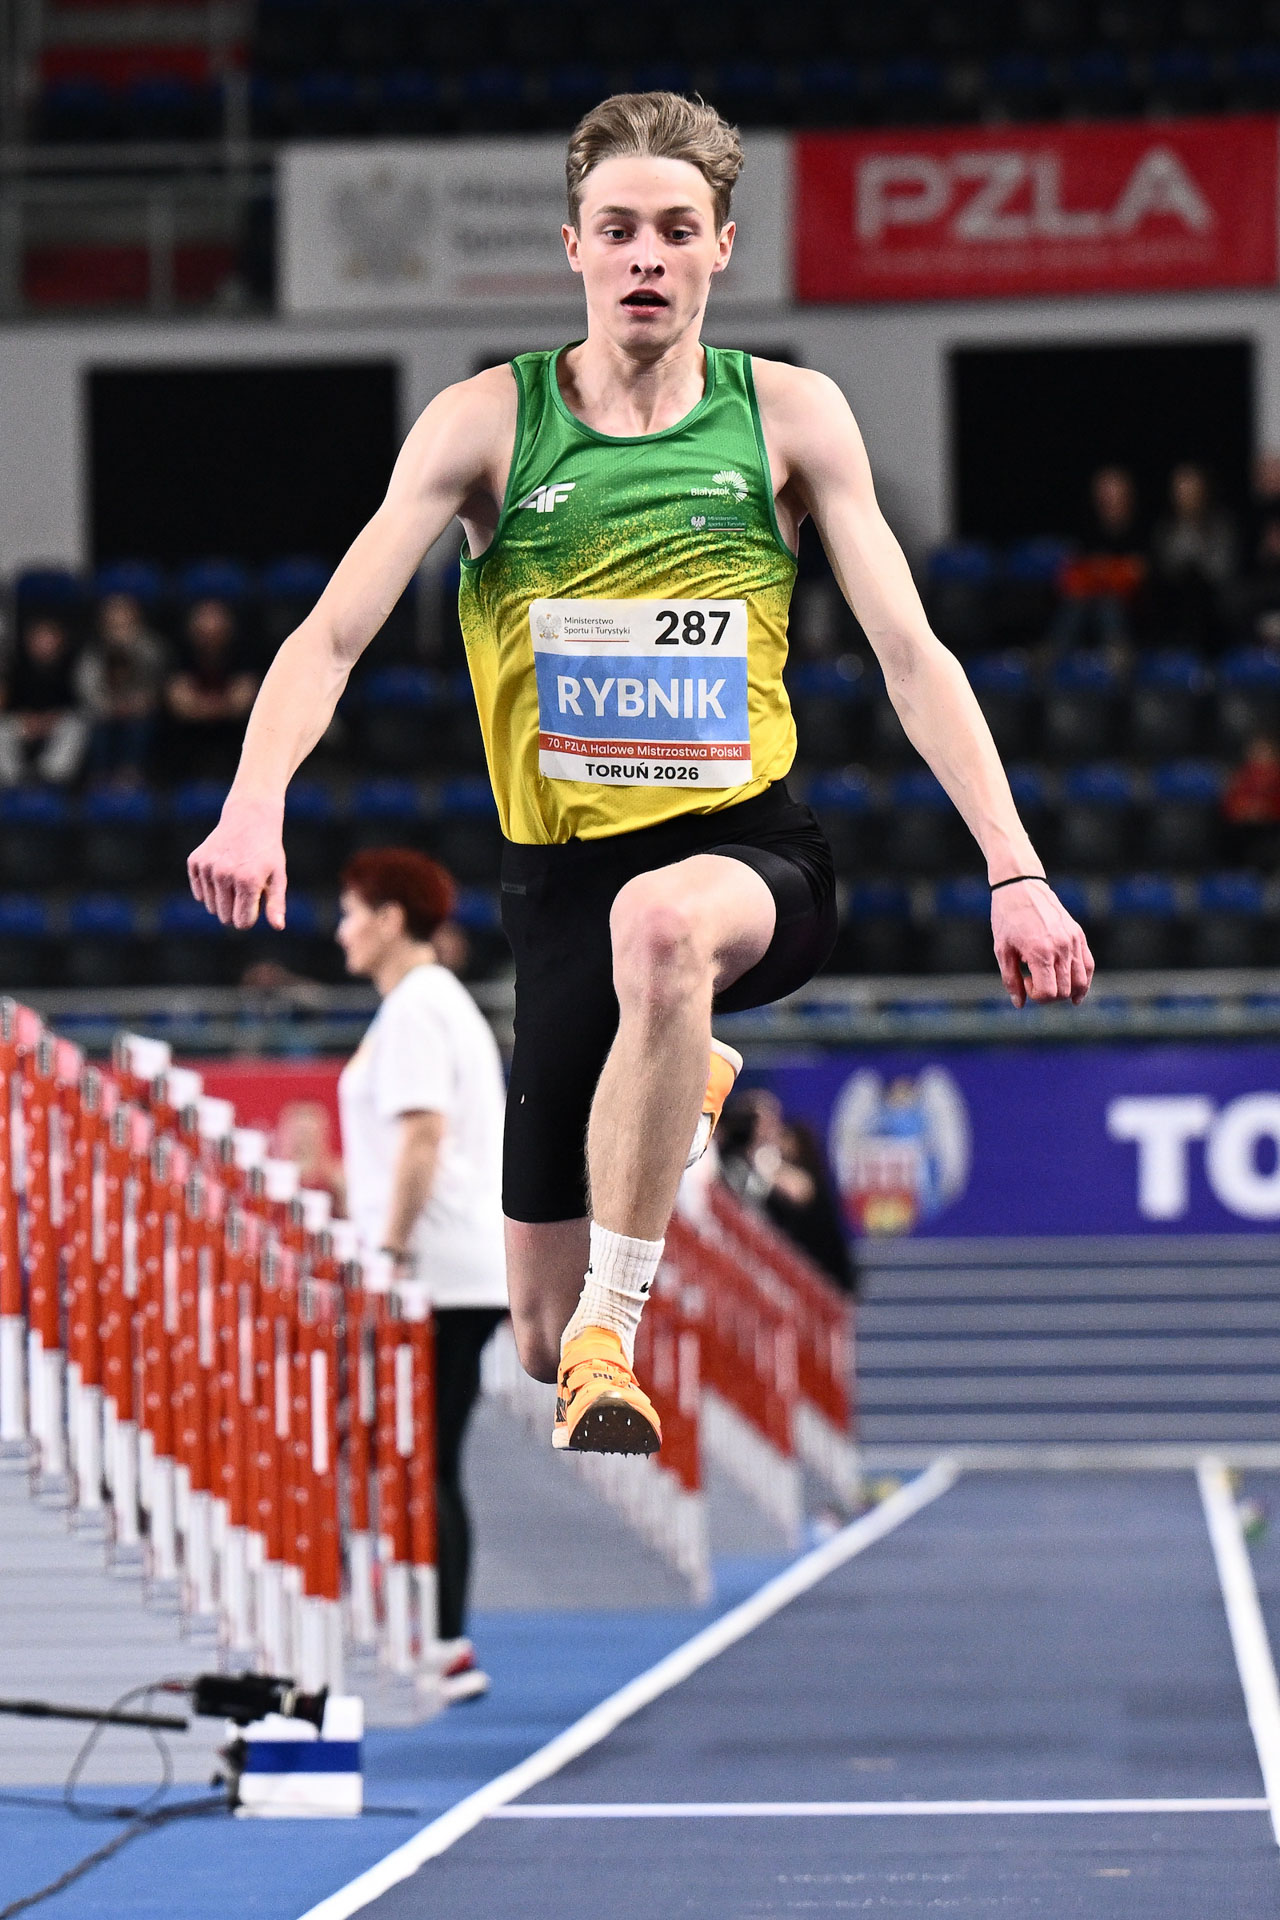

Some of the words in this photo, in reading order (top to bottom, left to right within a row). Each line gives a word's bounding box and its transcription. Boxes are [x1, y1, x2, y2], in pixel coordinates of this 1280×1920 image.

[854, 146, 1214, 244] PZLA
[563, 626, 589, 636] Sportu
[595, 627, 631, 636] Turystyki
[564, 616, 614, 625] Ministerstwo
[655, 610, 731, 646] 287
[557, 675, 727, 719] RYBNIK
[547, 737, 563, 750] 70.
[564, 740, 588, 754] PZLA
[590, 743, 634, 756] Halowe
[637, 746, 707, 758] Mistrzostwa
[710, 747, 743, 758] Polski
[585, 762, 649, 779] TORUŃ
[653, 766, 699, 780] 2026
